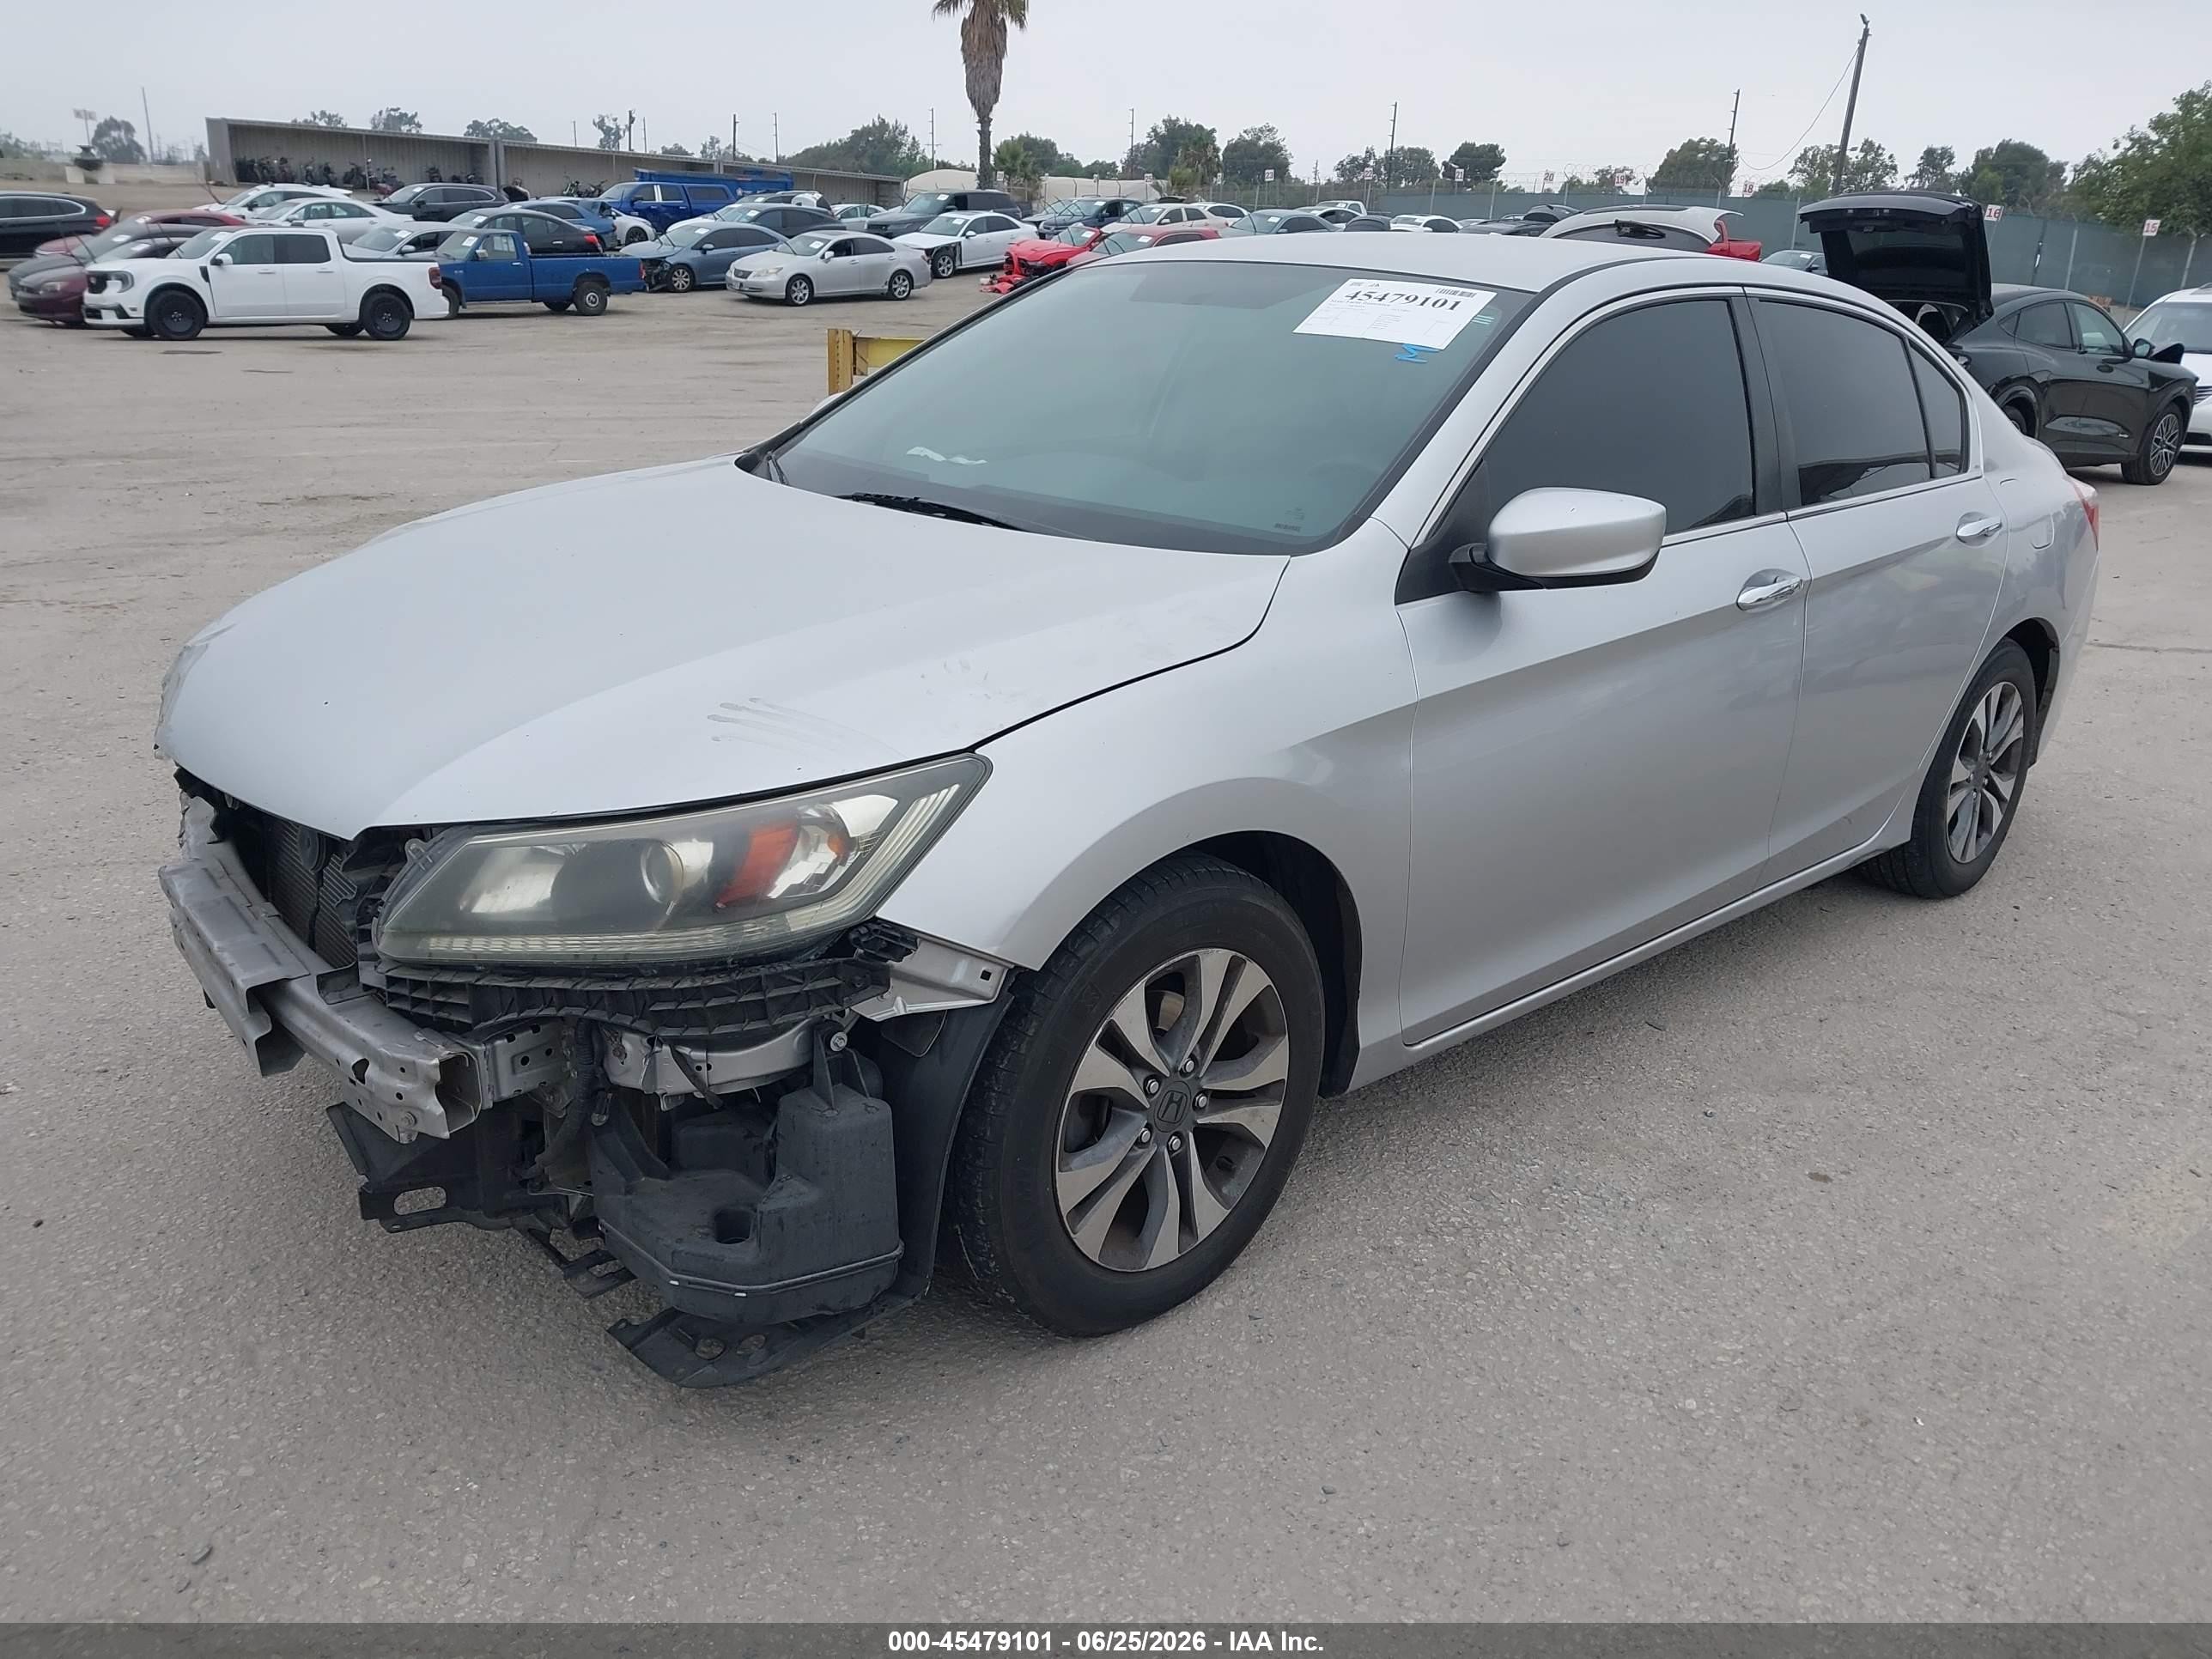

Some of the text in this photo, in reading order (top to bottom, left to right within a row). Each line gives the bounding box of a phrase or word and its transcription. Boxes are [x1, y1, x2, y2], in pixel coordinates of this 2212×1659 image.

[1455, 171, 1463, 179] 21
[1543, 173, 1554, 181] 20
[1615, 174, 1625, 184] 19
[1743, 183, 1753, 193] 18
[1986, 208, 2001, 218] 16
[2144, 222, 2157, 233] 15
[1345, 290, 1462, 311] 45479101
